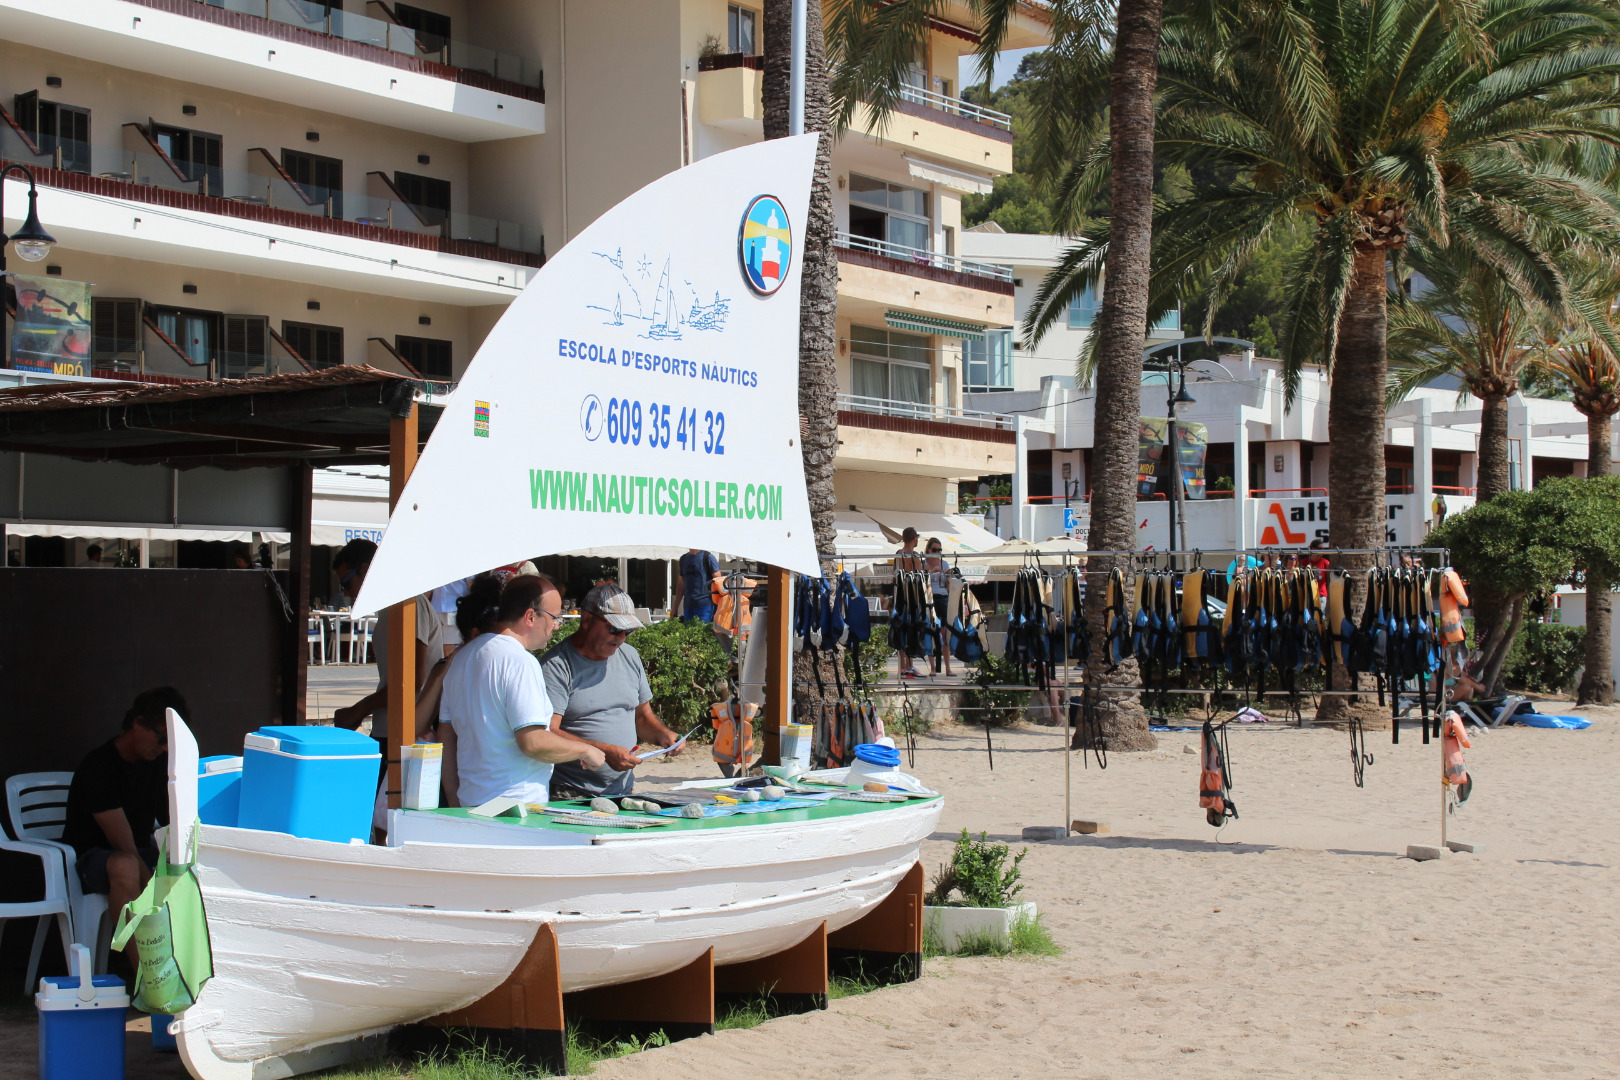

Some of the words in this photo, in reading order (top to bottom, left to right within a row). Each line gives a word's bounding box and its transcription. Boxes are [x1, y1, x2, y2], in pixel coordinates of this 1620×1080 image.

[54, 361, 83, 377] MIRÓ
[558, 338, 617, 366] ESCOLA
[622, 349, 697, 378] D'ESPORTS
[701, 360, 758, 388] NÀUTICS
[607, 397, 643, 447] 609
[649, 402, 671, 450] 35
[676, 407, 697, 453] 41
[703, 409, 726, 455] 32
[1139, 462, 1155, 475] MIRÓ
[529, 469, 783, 521] WWW.NAUTICSOLLER.COM
